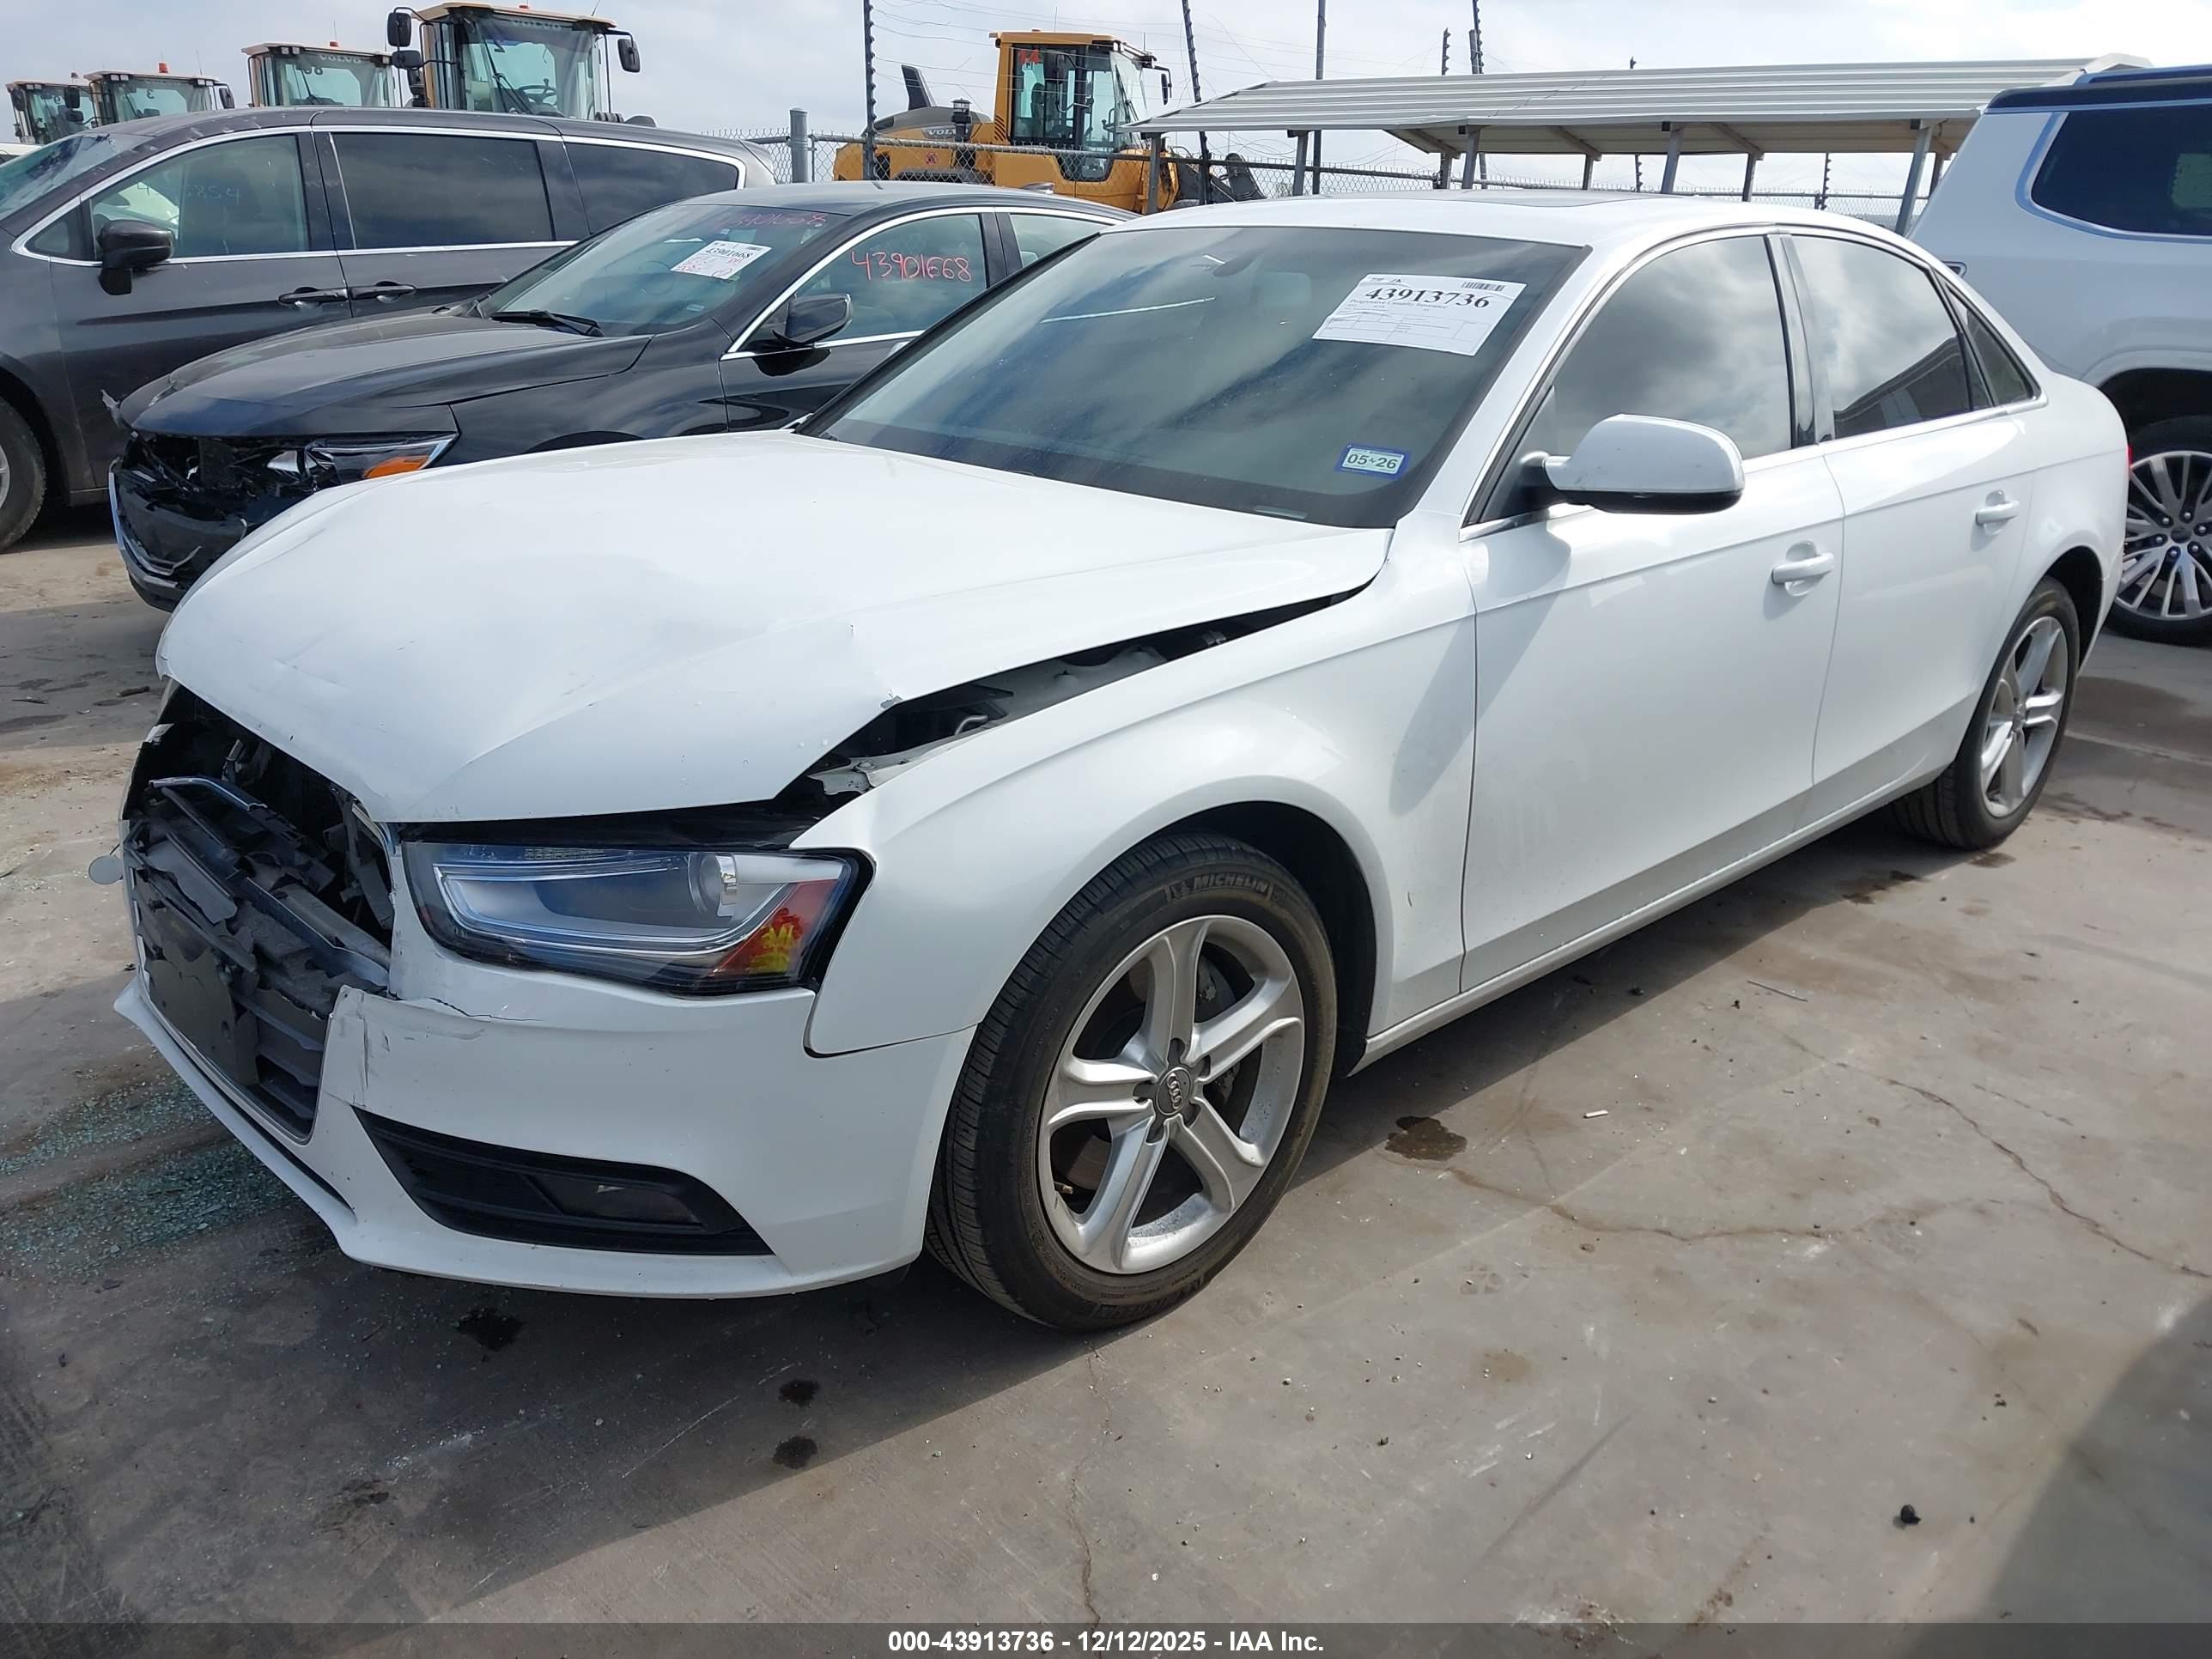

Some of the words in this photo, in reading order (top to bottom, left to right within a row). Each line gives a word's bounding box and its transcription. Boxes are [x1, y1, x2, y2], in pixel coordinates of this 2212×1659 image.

[319, 54, 362, 64] VOLVO
[851, 251, 972, 282] 43901668
[1365, 288, 1495, 309] 43913736
[1194, 872, 1269, 893] MICHELIN
